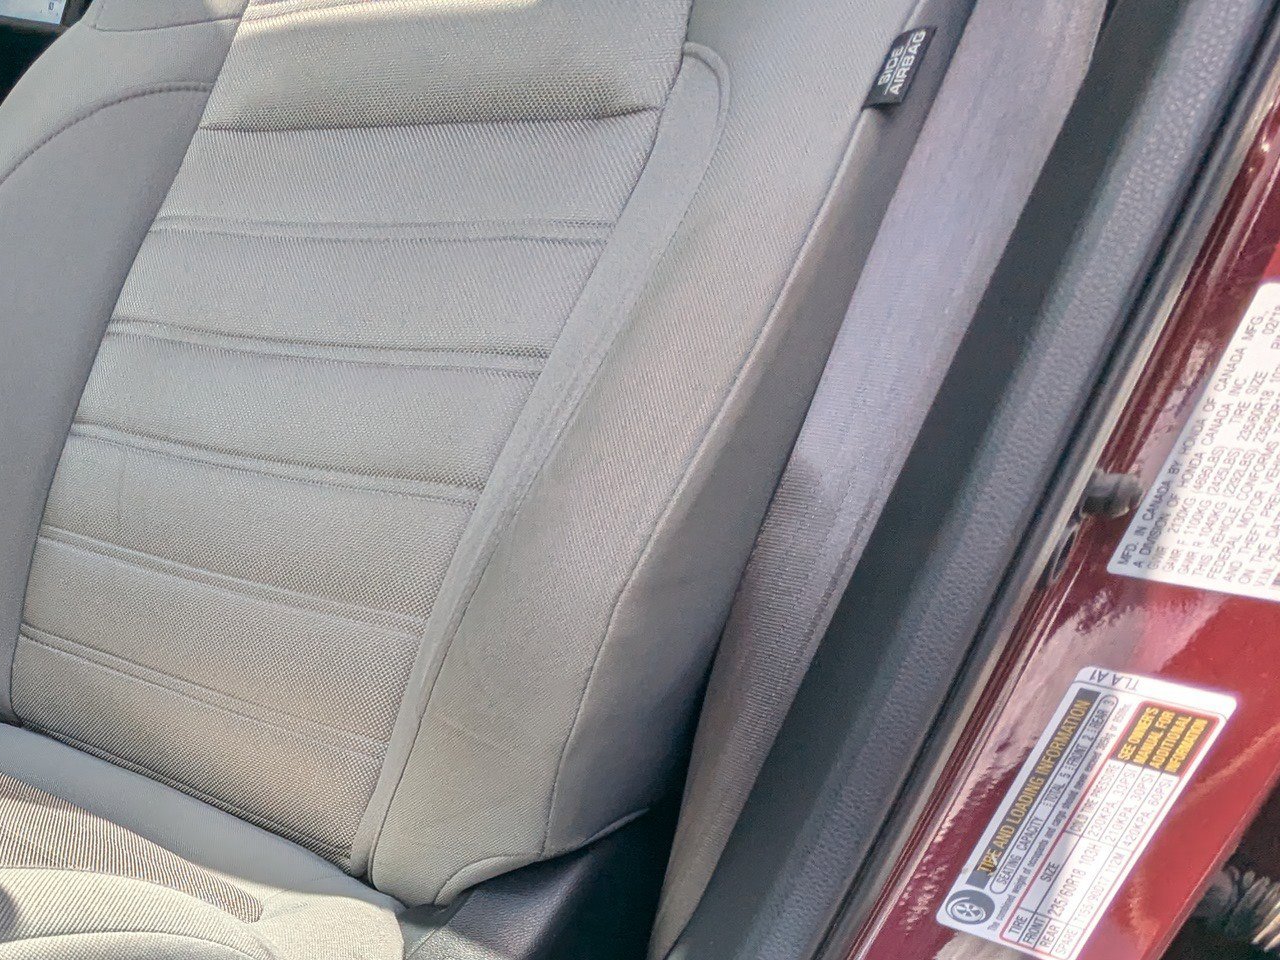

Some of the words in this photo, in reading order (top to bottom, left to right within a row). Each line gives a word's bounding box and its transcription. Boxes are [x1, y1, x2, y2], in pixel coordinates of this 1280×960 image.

[878, 46, 903, 85] SIDE
[890, 30, 926, 95] AIRBAG
[1228, 400, 1251, 425] TIRE
[1244, 370, 1268, 395] SIZE
[1133, 525, 1147, 536] IN
[1141, 479, 1173, 521] CANADA
[1167, 460, 1183, 474] BY
[1177, 417, 1208, 455] HONDA
[1201, 396, 1219, 412] OF
[1212, 346, 1247, 392] CANADA
[1131, 559, 1144, 568] A
[1138, 512, 1171, 555] DIVISION
[1164, 492, 1182, 508] OF
[1176, 451, 1206, 488] HONDA
[1199, 402, 1233, 446] CANADA
[1192, 553, 1213, 576] THIS
[1208, 506, 1241, 548] VEHICLE
[1234, 439, 1279, 502] CONFORMS
[1205, 532, 1242, 579] FEDERAL
[1235, 489, 1267, 529] MOTOR
[1221, 559, 1243, 582] AND
[1236, 521, 1266, 555] THEFT
[1237, 568, 1255, 584] ON
[1249, 542, 1271, 564] THE
[1116, 742, 1137, 760] SEE
[1126, 706, 1160, 744] OWNER'S
[1132, 727, 1164, 764] MANUAL
[1154, 709, 1175, 729] FOR
[1147, 713, 1192, 769] ADDITIONAL
[1163, 717, 1208, 773] INFORMATION
[976, 847, 1003, 874] TIRE
[991, 823, 1016, 848] AND
[1005, 775, 1045, 824] LOADING
[1034, 699, 1091, 775] INFORMATION
[995, 853, 1022, 885] SEATING
[1015, 815, 1044, 851] CAPACITY
[1044, 780, 1065, 803] TOTAL
[1066, 743, 1088, 766] FRONT
[1088, 708, 1108, 729] REAR
[1007, 914, 1028, 935] TIRE
[1039, 861, 1060, 882] SIZE
[1089, 762, 1121, 799] PRESSURE
[1038, 923, 1061, 948] REAR
[1129, 772, 1156, 801] 30PSI
[1046, 867, 1087, 917] 235/60R18
[1077, 842, 1103, 867] 103H
[1021, 916, 1047, 944] FRONT
[1054, 928, 1078, 955] SPARE
